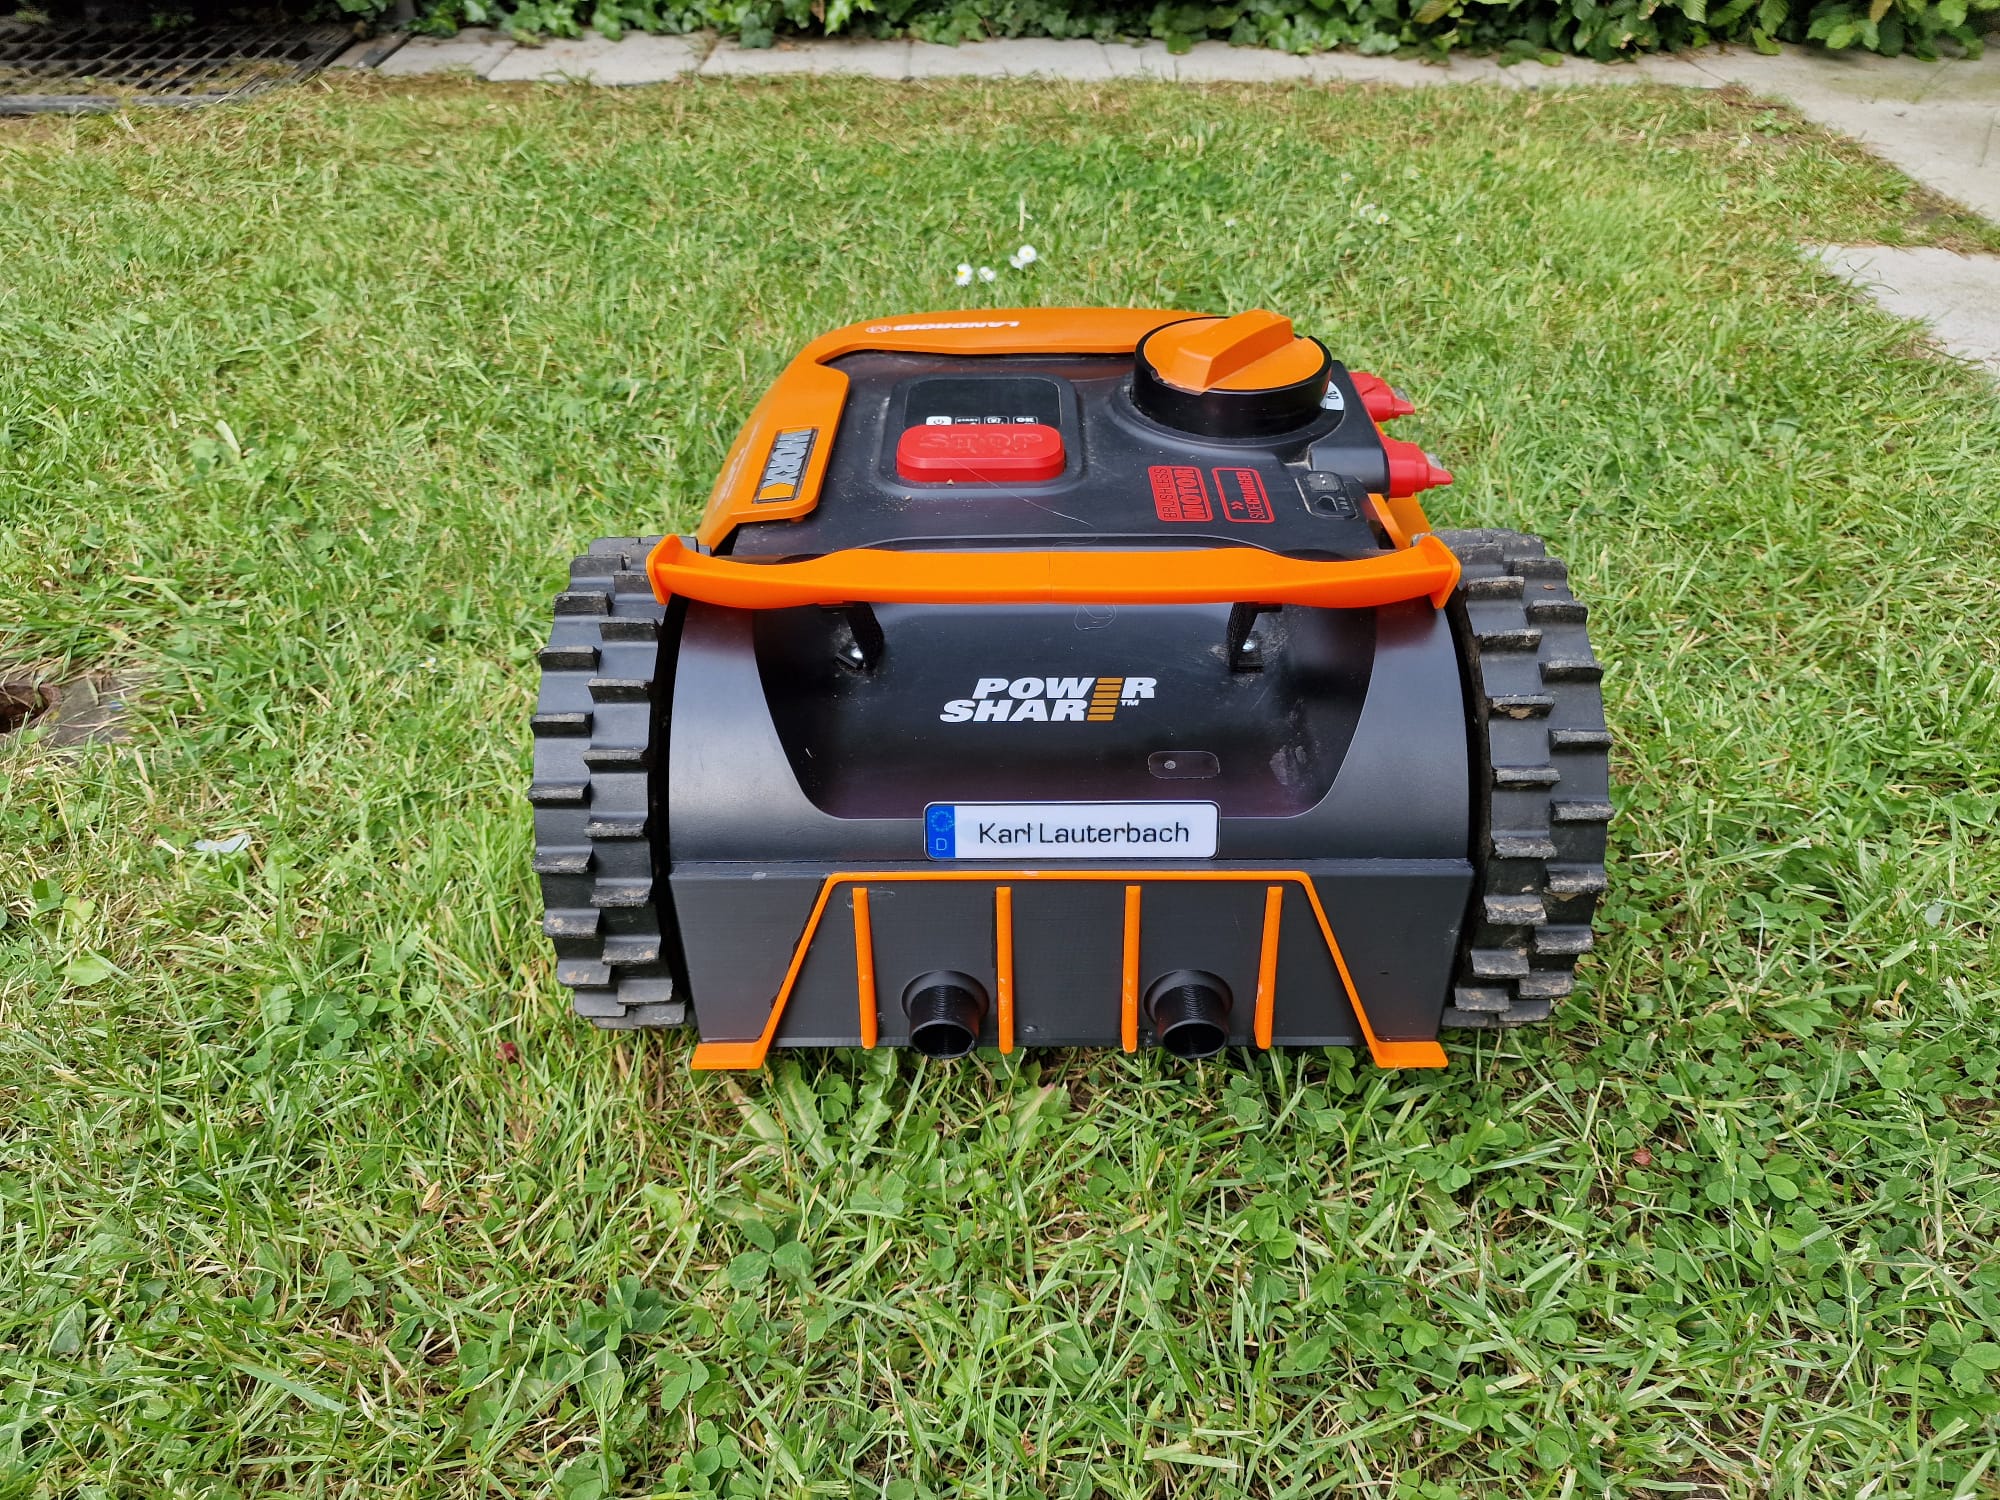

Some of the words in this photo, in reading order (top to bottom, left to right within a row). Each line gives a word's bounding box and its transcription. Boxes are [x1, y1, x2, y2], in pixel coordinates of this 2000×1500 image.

[761, 429, 812, 489] WORX
[919, 432, 1043, 452] STOP
[1153, 468, 1178, 518] BRUSHLESS
[1173, 469, 1207, 520] MOTOR
[935, 837, 948, 851] D
[978, 822, 1032, 844] Karl
[1039, 822, 1190, 844] Lauterbach
